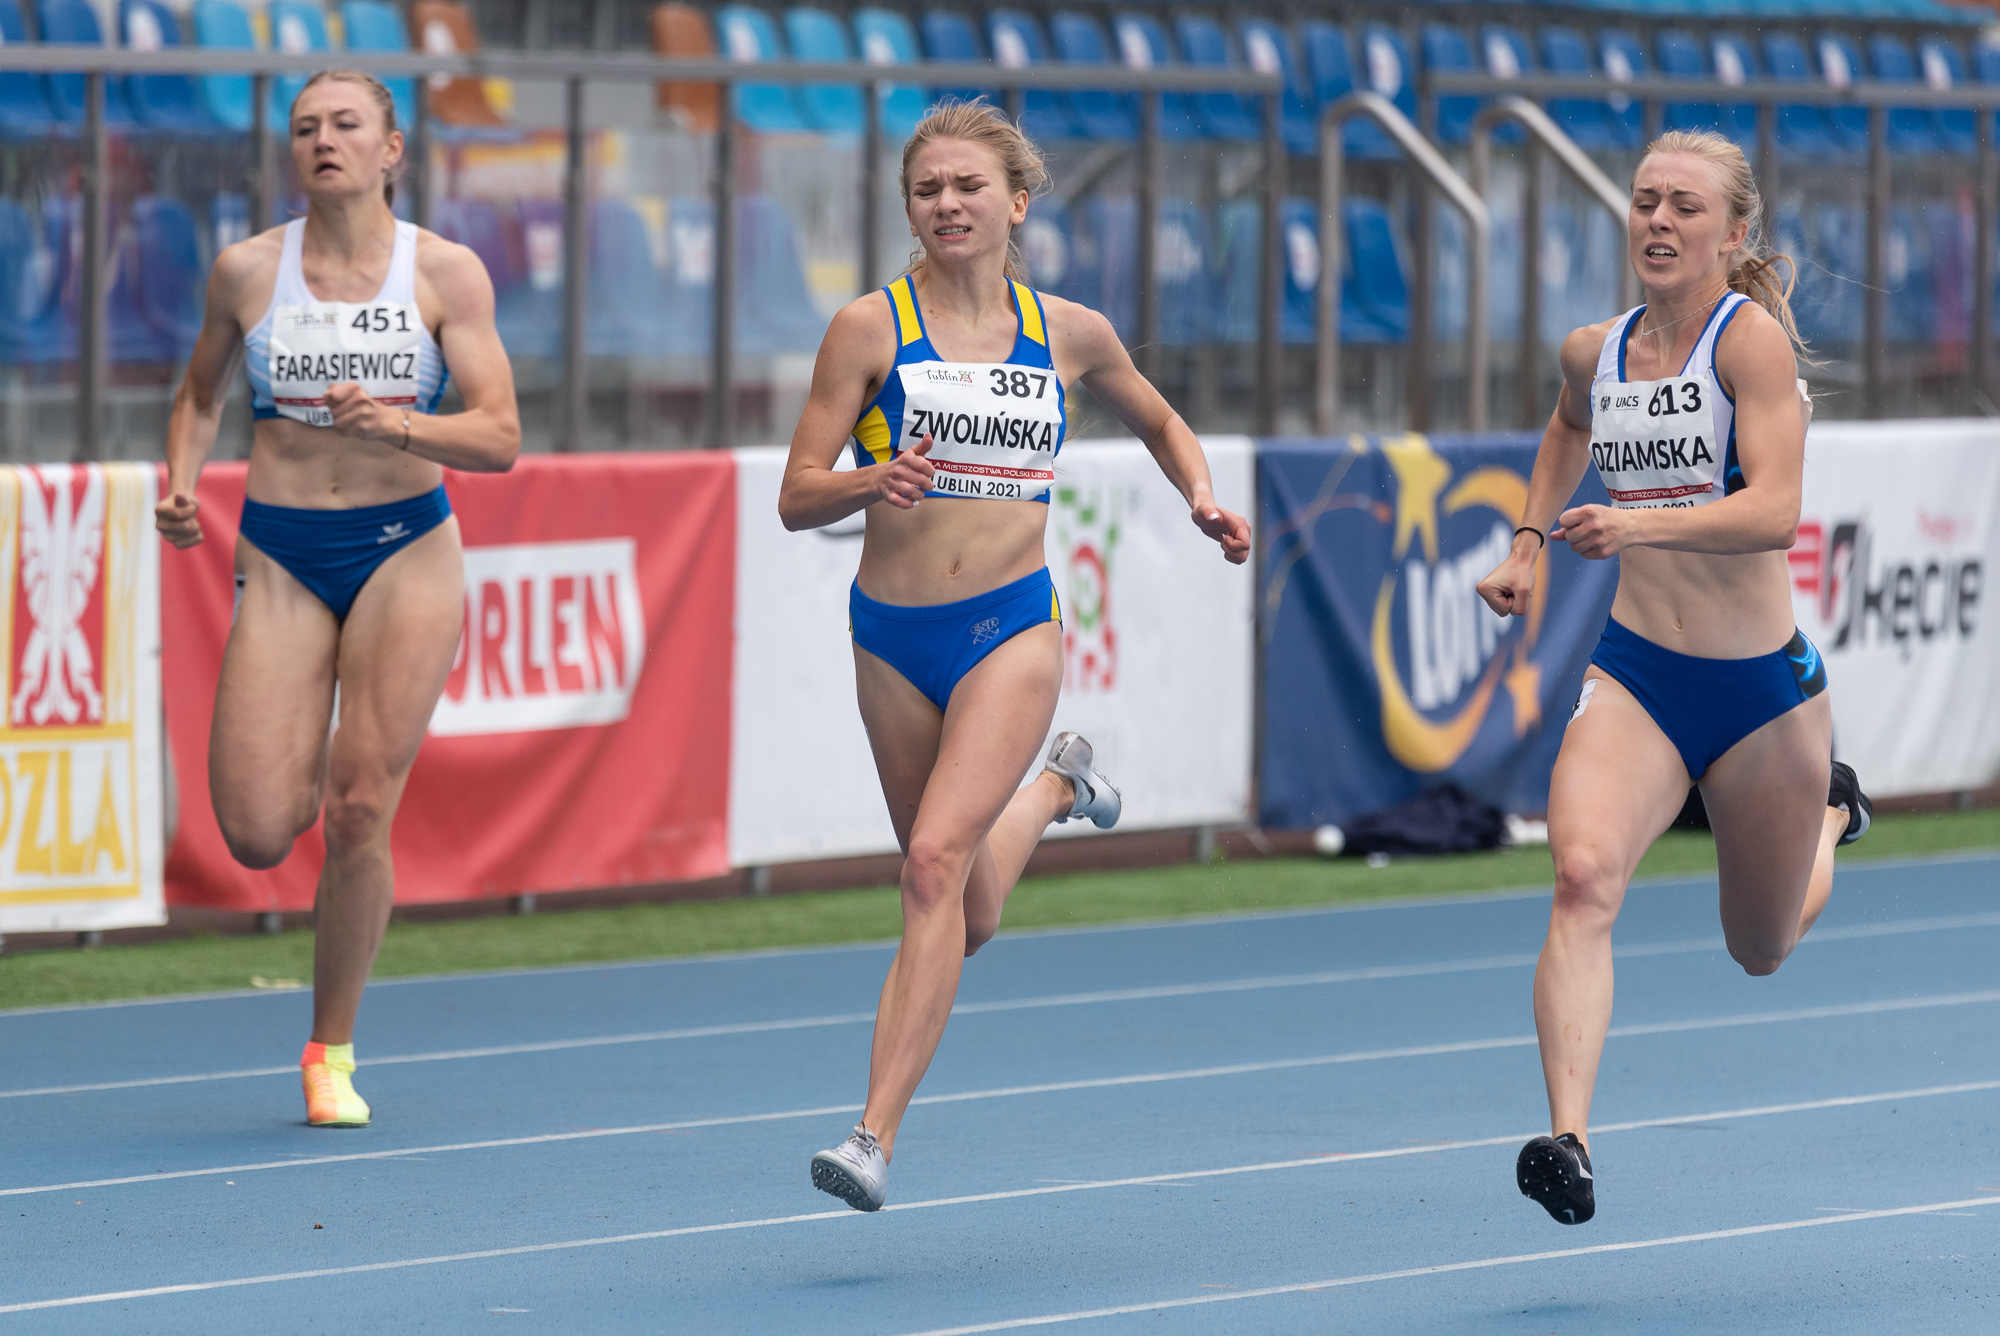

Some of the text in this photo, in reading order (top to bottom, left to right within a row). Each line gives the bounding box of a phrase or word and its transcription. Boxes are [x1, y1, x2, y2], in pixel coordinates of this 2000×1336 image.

[351, 308, 411, 333] 451
[275, 353, 415, 382] FARASIEWICZ
[989, 368, 1048, 399] 387
[1648, 382, 1702, 417] 613
[305, 410, 331, 425] LUB
[909, 409, 1052, 452] ZWOLIŃSKA
[942, 462, 1002, 475] MISTRZOSTWA
[1003, 470, 1030, 478] POLSKI
[987, 481, 1021, 498] 2021
